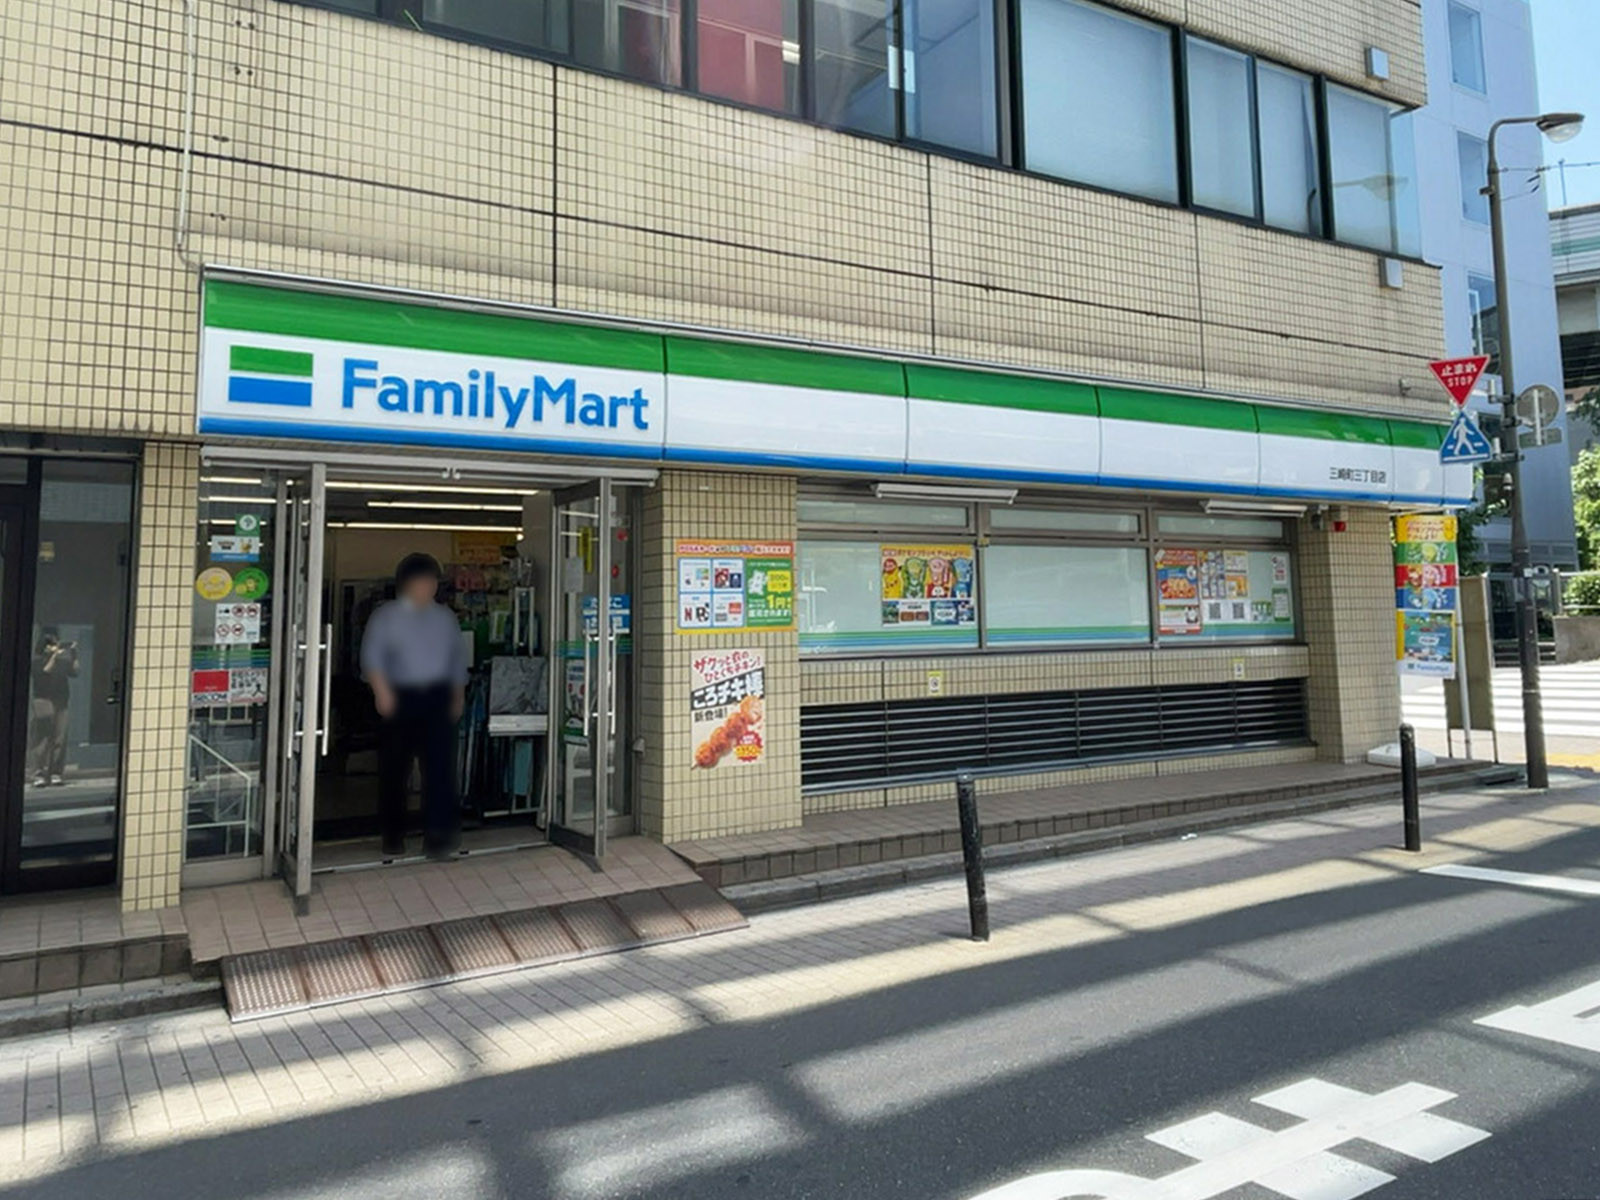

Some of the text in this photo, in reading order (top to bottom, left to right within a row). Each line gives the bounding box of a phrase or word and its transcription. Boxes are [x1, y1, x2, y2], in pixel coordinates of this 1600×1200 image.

[1441, 363, 1478, 377] 止まれ
[1447, 376, 1473, 388] STOP
[341, 357, 650, 430] FamilyMart
[1329, 466, 1387, 484] 三崎町三丁目店
